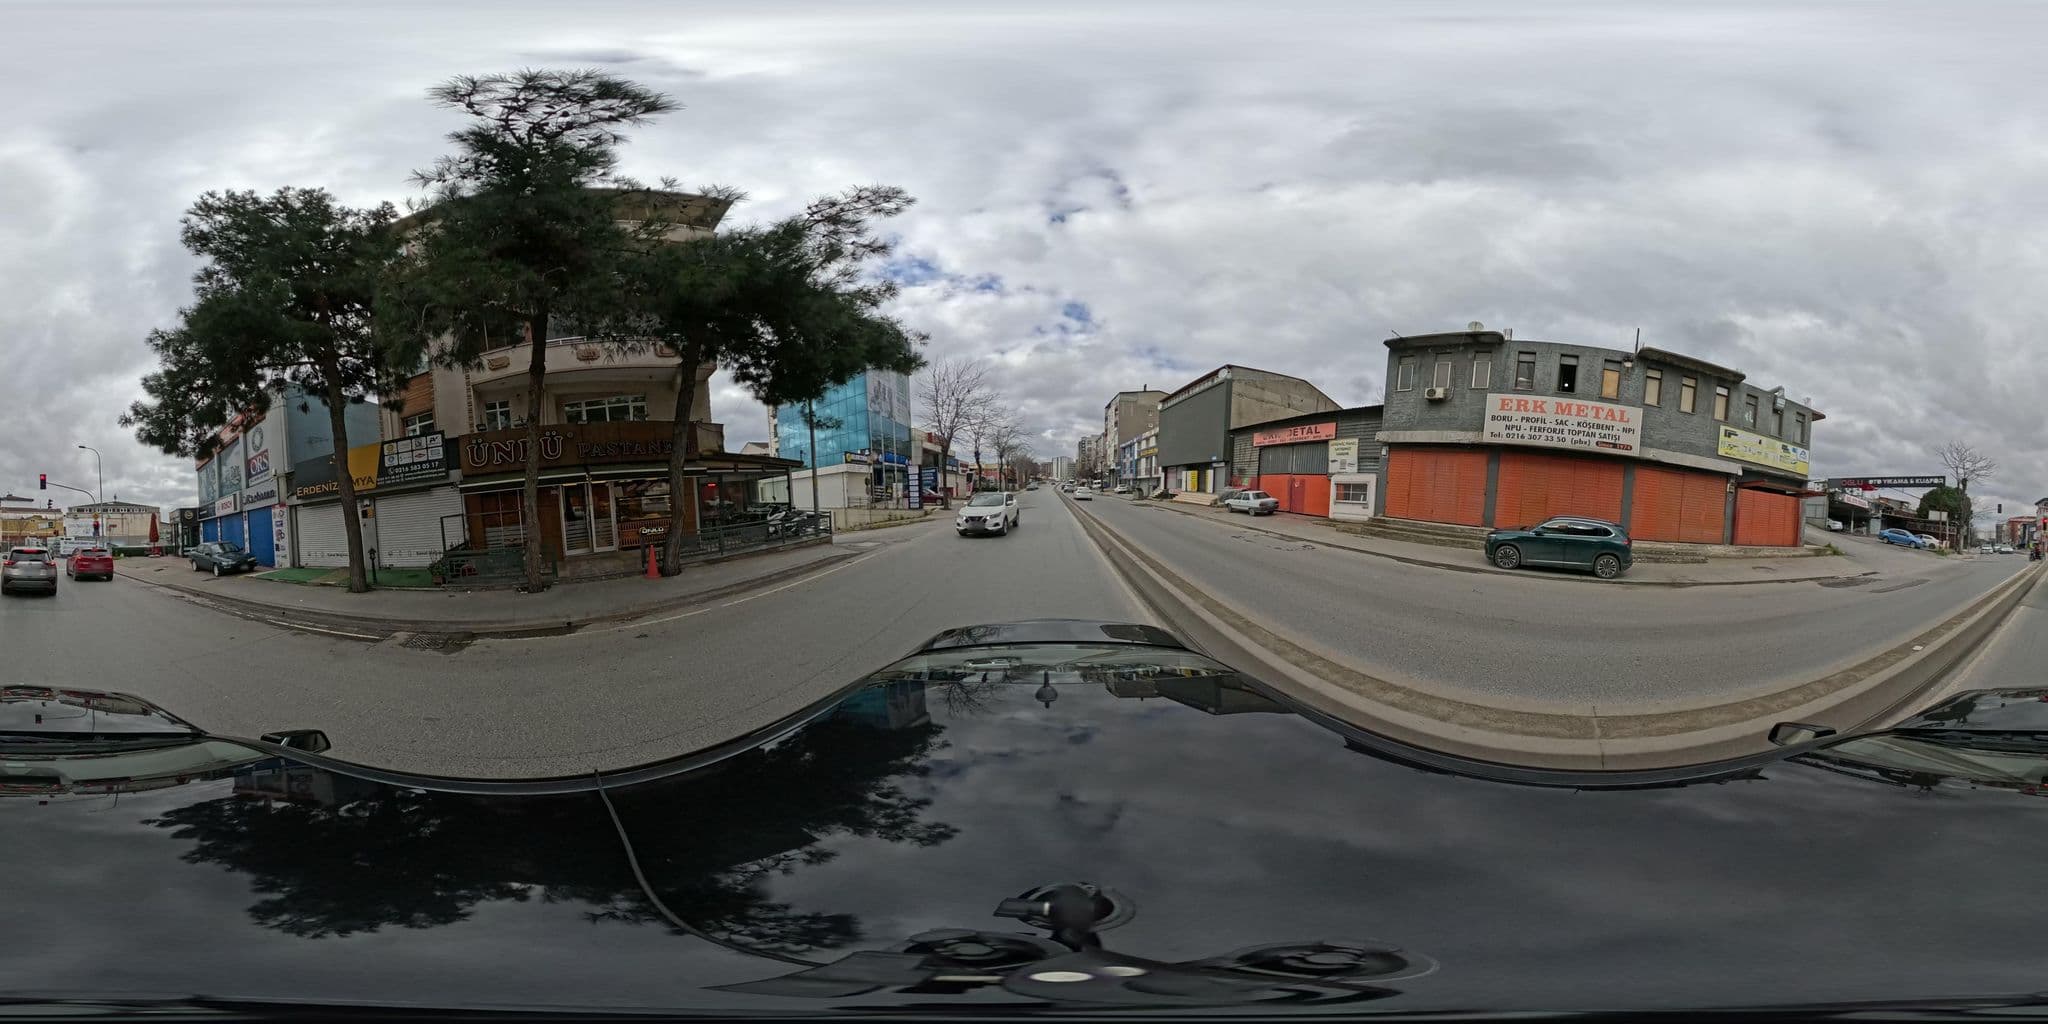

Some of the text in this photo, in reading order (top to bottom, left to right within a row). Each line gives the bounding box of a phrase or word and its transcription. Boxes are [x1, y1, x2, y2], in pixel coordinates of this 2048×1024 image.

[1499, 398, 1630, 423] ERK METAL
[1505, 424, 1522, 432] NPU
[1530, 426, 1565, 435] FERFORJE
[1568, 429, 1596, 438] TOPTAN
[1521, 416, 1547, 424] PROFİL
[1577, 420, 1614, 432] KÖŞEBENT
[1506, 432, 1525, 440] 0216
[250, 452, 269, 474] ORS
[296, 480, 339, 496] ERDENİZ
